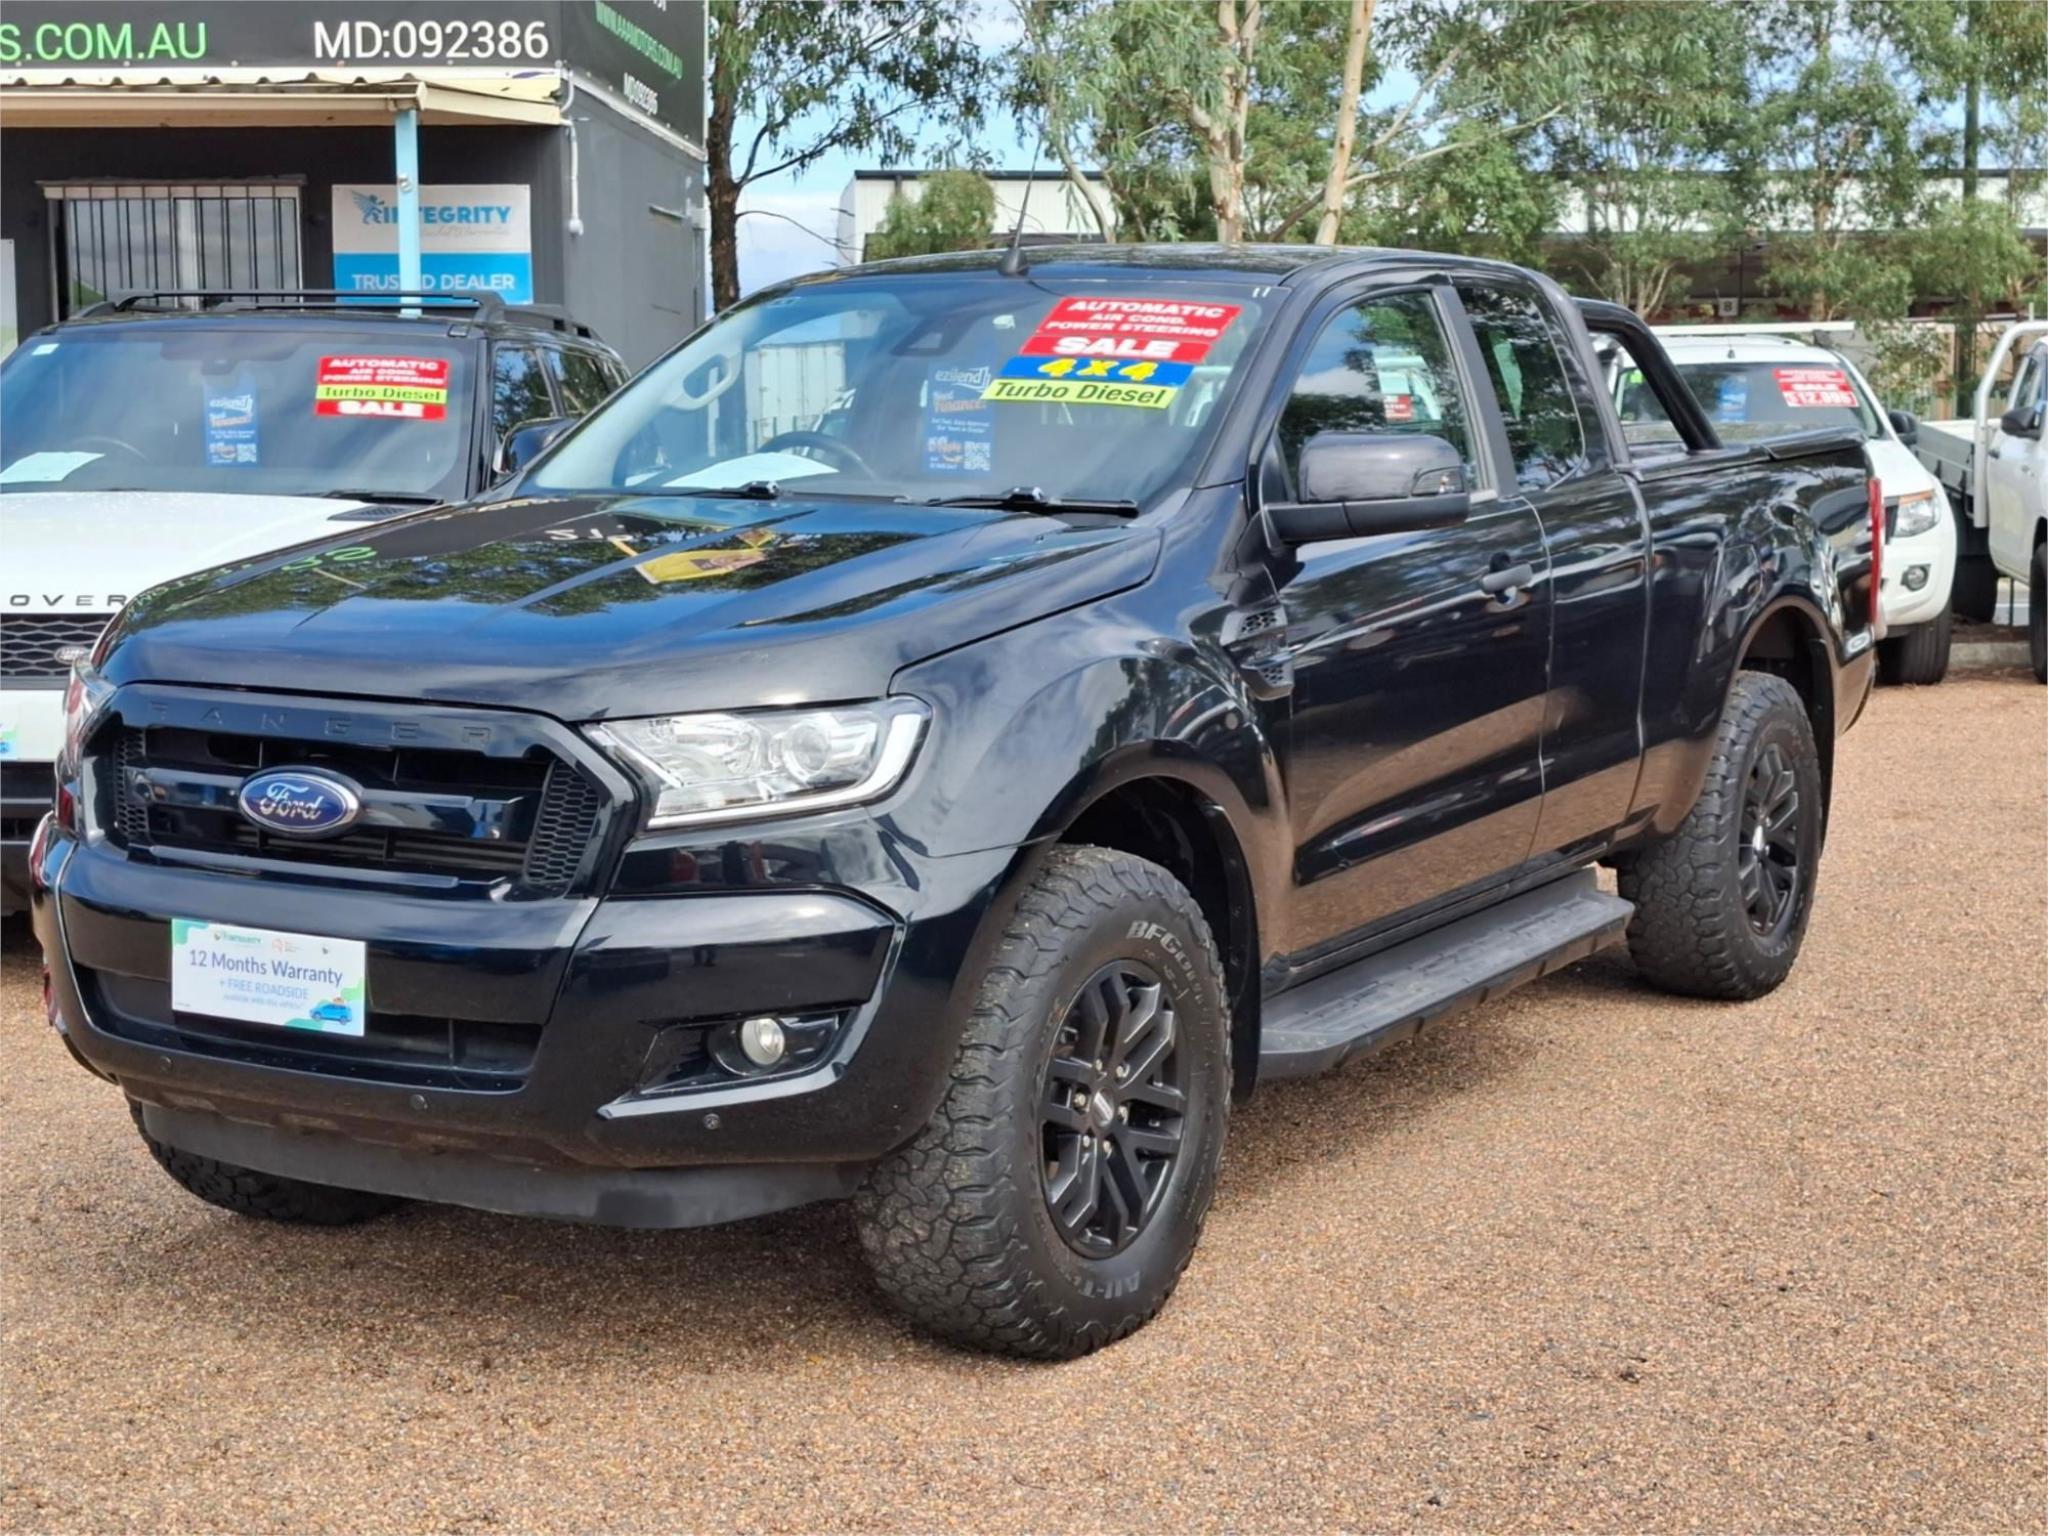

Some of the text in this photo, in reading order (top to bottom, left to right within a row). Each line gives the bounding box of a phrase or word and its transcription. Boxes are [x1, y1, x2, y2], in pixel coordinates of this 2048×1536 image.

[313, 20, 549, 59] MD:092386
[383, 206, 511, 225] IEGRITY
[352, 274, 515, 291] TRUSD DEALER
[1068, 300, 1226, 319] AUTOMATIC
[1089, 313, 1126, 322] AIR
[1045, 321, 1219, 338] POWER STEERING
[1053, 336, 1180, 359] SALE
[329, 359, 439, 371] AUTOMATIC
[325, 387, 440, 401] Turbo Diesel
[994, 381, 1168, 405] Turbo Diesel
[337, 400, 423, 417] SALE
[9, 594, 128, 607] OVER
[259, 782, 325, 820] Ford
[189, 949, 343, 987] 12 Months Warranty
[228, 978, 254, 993] FREE
[255, 980, 309, 1000] ROADSIDE
